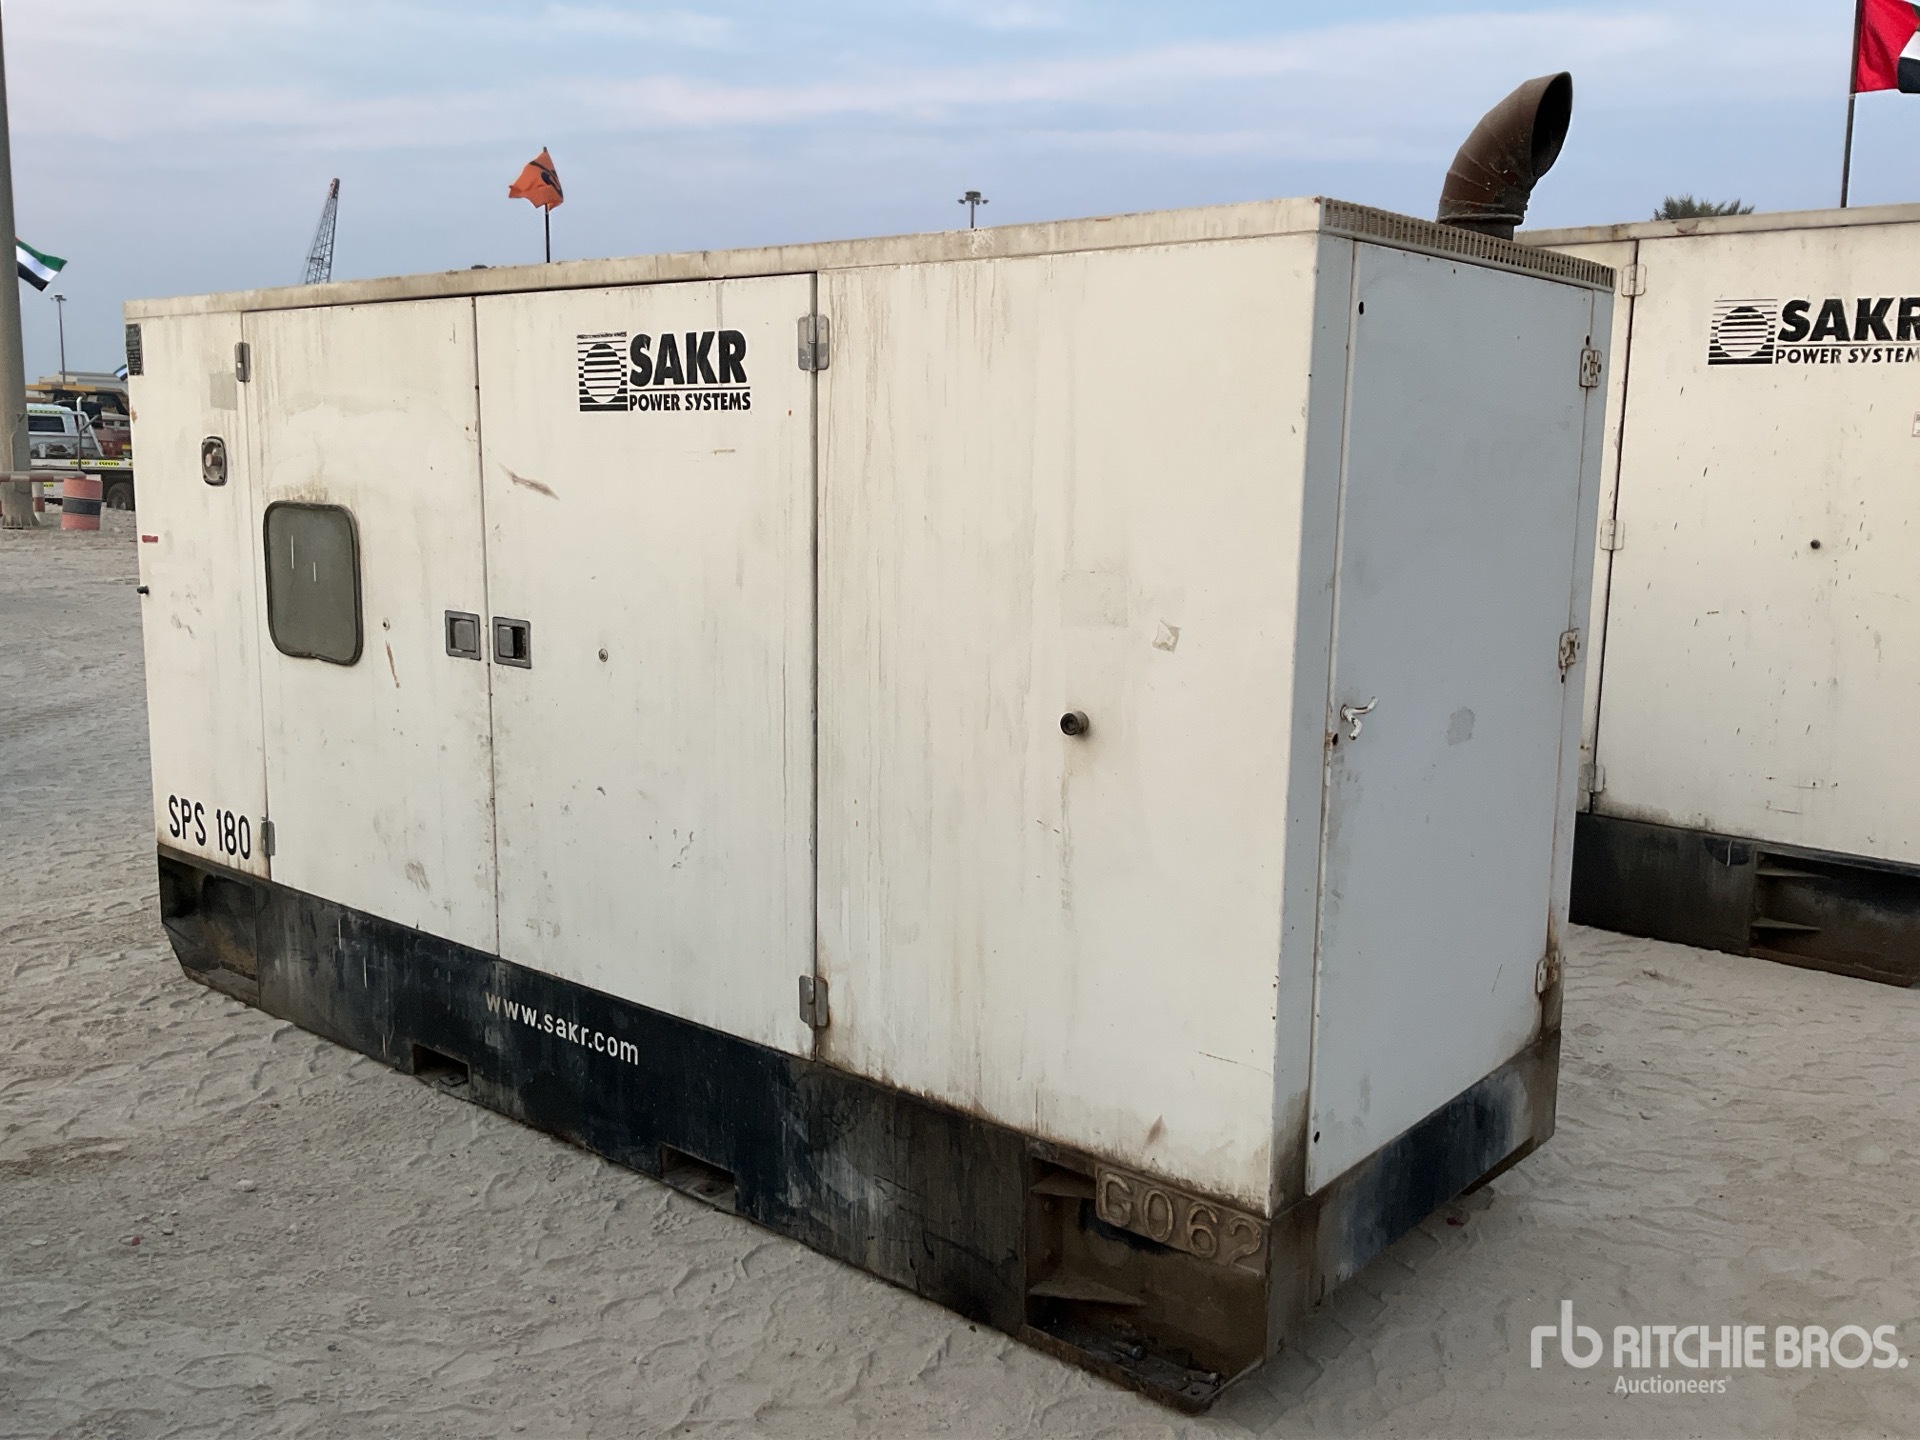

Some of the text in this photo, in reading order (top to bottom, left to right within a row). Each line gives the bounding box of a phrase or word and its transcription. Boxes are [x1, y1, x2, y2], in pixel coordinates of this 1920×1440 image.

[1777, 297, 1920, 342] SAKR
[629, 330, 747, 387] SAKR
[1774, 348, 1842, 364] POWER
[629, 391, 751, 411] POWER SYSTEMS
[168, 794, 251, 860] SPS 180
[485, 991, 639, 1066] www.sakr.com
